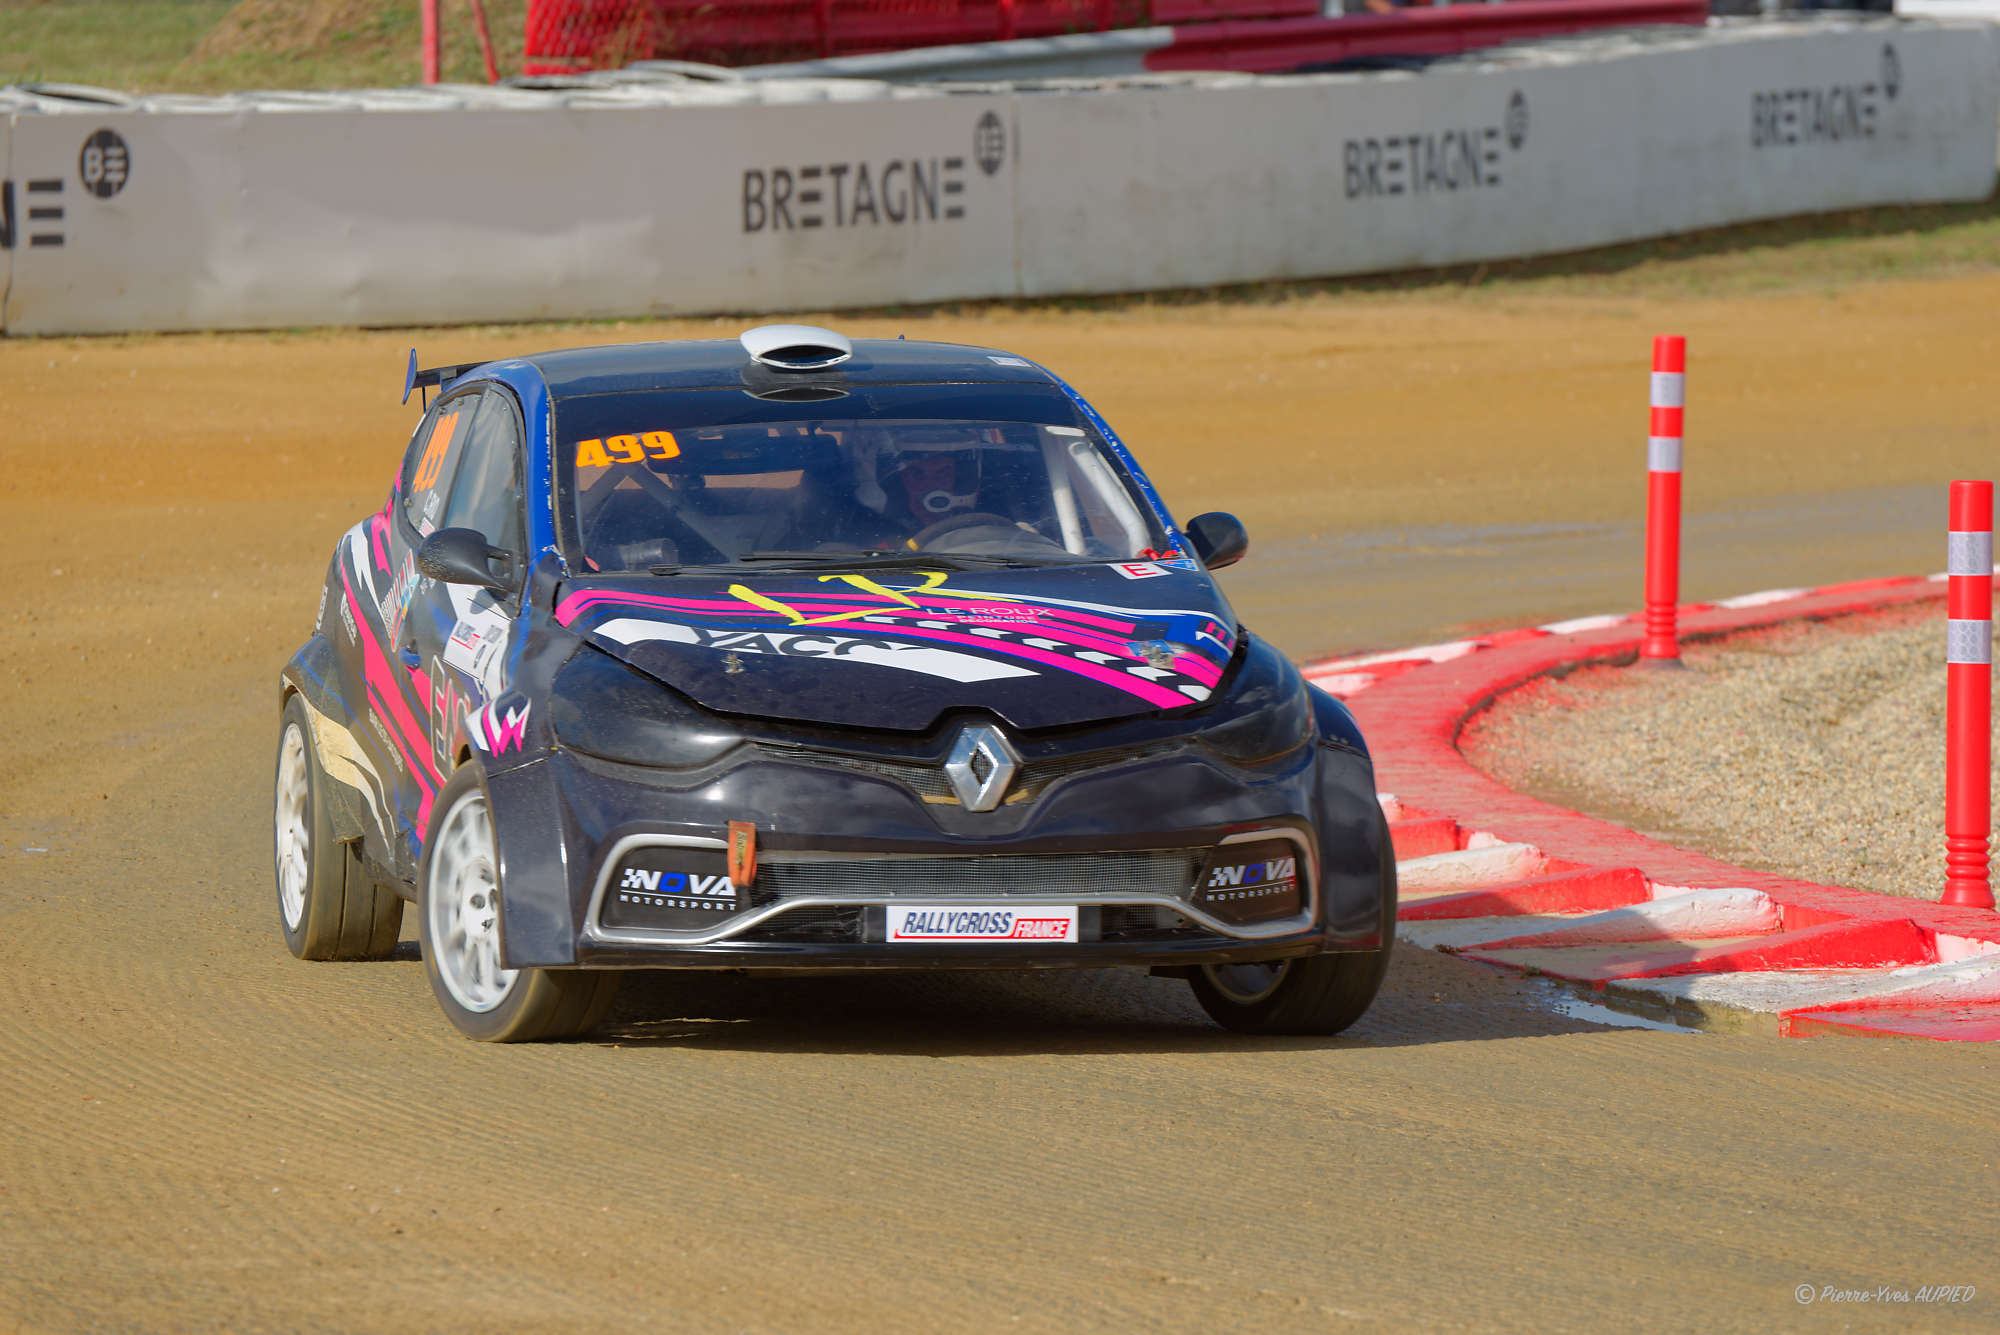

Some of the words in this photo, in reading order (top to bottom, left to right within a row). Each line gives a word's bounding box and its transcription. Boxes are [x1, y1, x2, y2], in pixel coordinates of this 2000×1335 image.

[1752, 84, 1877, 147] BRETAGNE
[1344, 129, 1499, 198] BRETAGNE
[743, 157, 965, 232] BRETAGNE
[576, 431, 680, 467] 499
[1120, 564, 1158, 576] E
[926, 607, 966, 615] LE
[970, 607, 1054, 616] ROUX
[692, 628, 930, 657] YACC
[620, 868, 737, 896] NOVA
[1208, 857, 1296, 887] NOVA
[619, 894, 737, 911] MOTORSPORT
[903, 912, 1012, 934] RALLYCROSS
[1015, 920, 1067, 938] FRANCE
